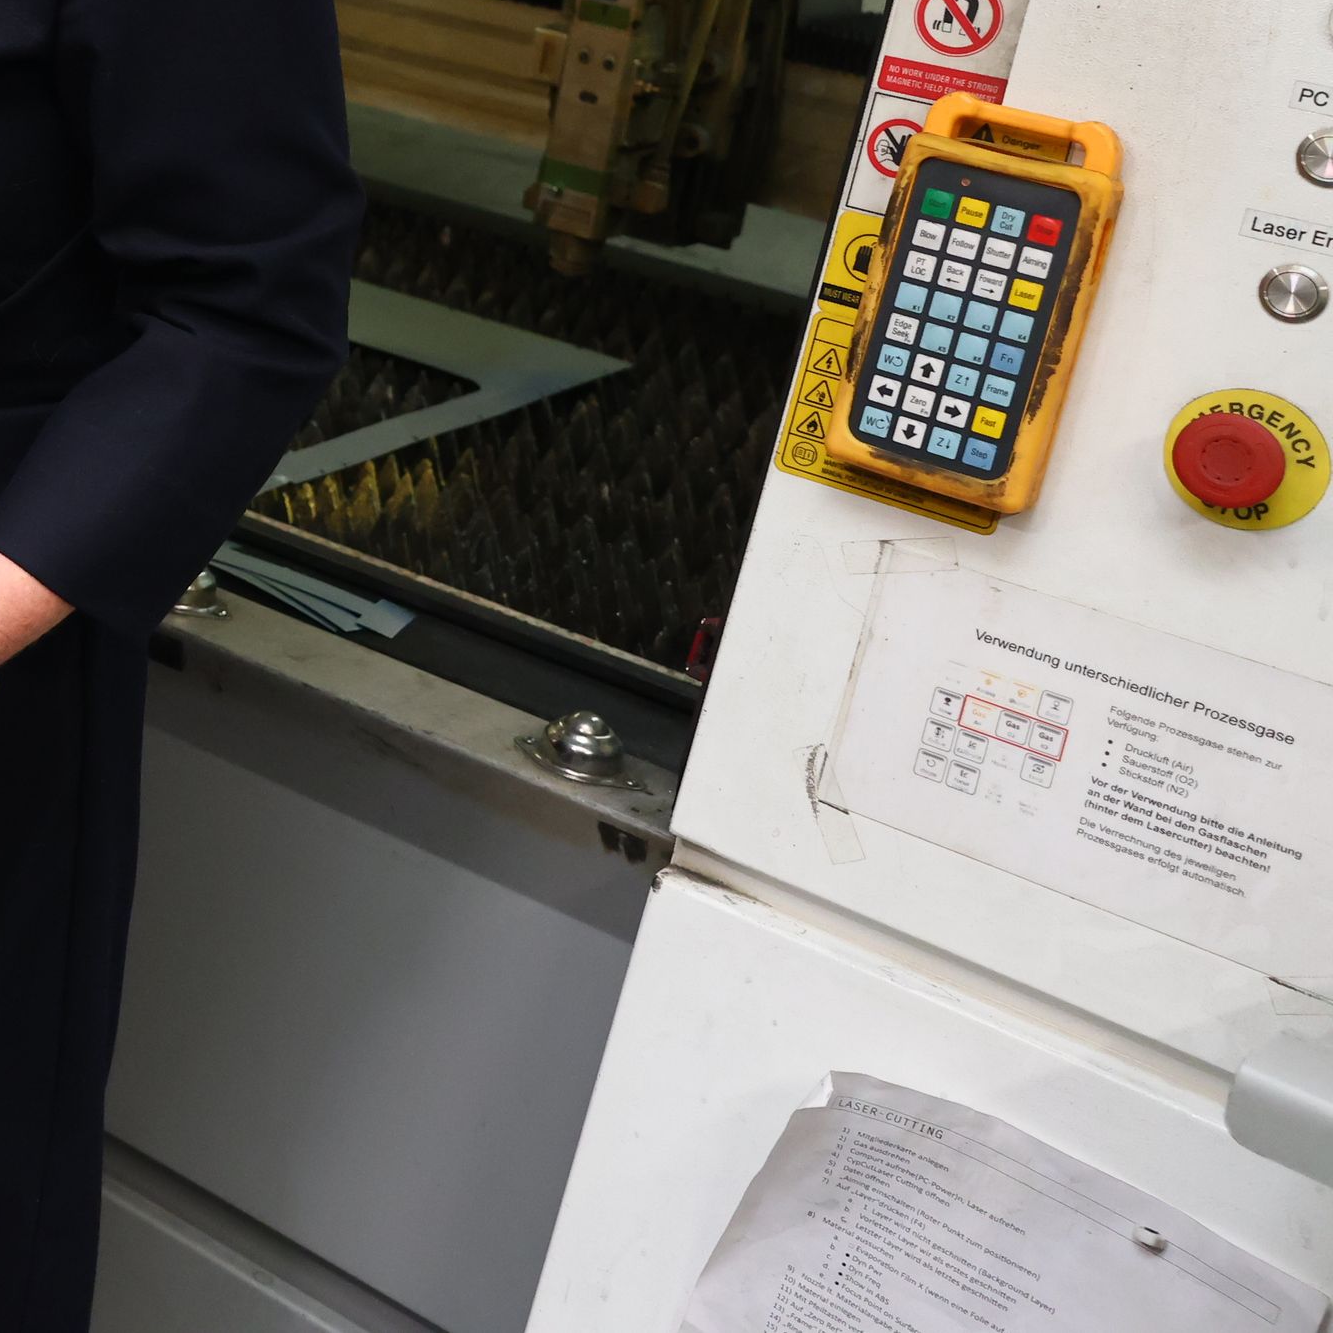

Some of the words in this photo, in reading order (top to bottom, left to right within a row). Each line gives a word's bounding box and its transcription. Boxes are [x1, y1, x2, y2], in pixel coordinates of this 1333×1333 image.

[886, 75, 922, 89] MAGNETIC
[923, 82, 942, 93] FIELD
[889, 65, 900, 74] NO
[902, 68, 923, 78] WORK
[925, 72, 950, 84] UNDER
[952, 77, 966, 86] THE
[967, 80, 999, 94] STRONG
[1298, 88, 1329, 107] PC
[1002, 135, 1041, 151] Danger
[961, 206, 983, 219] Pause
[1002, 212, 1016, 222] Dry
[999, 222, 1013, 231] Cut
[1251, 216, 1307, 241] Laser
[920, 230, 937, 240] Blow
[952, 238, 975, 250] Follow
[986, 247, 1011, 259] Shutter
[916, 257, 926, 265] PT
[1022, 256, 1048, 270] Aiming
[911, 266, 926, 276] LOC
[947, 266, 964, 277] Back
[823, 287, 841, 298] MUST
[842, 293, 860, 304] WEAR
[1015, 289, 1036, 300] Laser
[894, 319, 913, 330] Edge
[892, 327, 909, 338] Seek
[1001, 353, 1014, 364] Fn
[955, 375, 963, 384] Z
[986, 384, 1009, 397] Frame
[910, 396, 927, 406] Zero
[981, 417, 996, 428] Fast
[937, 437, 944, 447] Z
[971, 447, 988, 459] Step
[975, 628, 1060, 669] Verwendung
[1064, 661, 1189, 709] unterschiedlicher
[1192, 701, 1294, 744] Prozessgase
[1005, 720, 1020, 731] Gas
[1038, 732, 1054, 742] Gas
[1109, 705, 1156, 727] Folgende
[1158, 721, 1224, 750] Prozessgase
[1226, 746, 1262, 763] stehen
[1264, 759, 1282, 770] zur
[1124, 742, 1169, 765] Druckluft
[1171, 759, 1193, 774] (Air)
[1121, 754, 1173, 778] Sauerstoff
[1118, 766, 1165, 788] Stickstoff
[1166, 783, 1188, 798] (N2)
[1087, 788, 1100, 798] an
[1102, 794, 1121, 805] der
[1123, 799, 1153, 817] Wand
[1155, 811, 1172, 824] bei
[1173, 820, 1195, 832] den
[1197, 827, 1267, 858] Gasflaschen
[1091, 775, 1108, 788] Vor
[1110, 784, 1129, 795] der
[1131, 789, 1197, 822] Verwendung
[1199, 815, 1224, 830] bitte
[1226, 826, 1244, 837] die
[1246, 832, 1302, 859] Anleitung
[1084, 799, 1118, 816] (hinter
[1120, 812, 1143, 826] dem
[1146, 821, 1212, 853] Lasercutter)
[1214, 846, 1270, 872] beachten!
[1076, 827, 1145, 859] Prozessgases
[1147, 856, 1179, 873] erfolgt
[1079, 816, 1096, 829] Die
[1099, 823, 1161, 855] Verrechnung
[1162, 849, 1182, 861] des
[1183, 857, 1236, 881] jeweiligen
[838, 1099, 944, 1140] LASER-CUTTING
[853, 1140, 868, 1151] Gas
[869, 1145, 911, 1165] ausdrehen
[857, 1131, 917, 1157] Mitgliederkarte
[918, 1154, 949, 1172] anlegen
[823, 1217, 855, 1237] Material
[855, 1235, 894, 1260] aussuchen
[852, 1255, 867, 1267] Dyn
[848, 1265, 863, 1278] Dyn
[865, 1272, 881, 1289] Freq
[845, 1274, 865, 1290] Show
[866, 1286, 874, 1295] in
